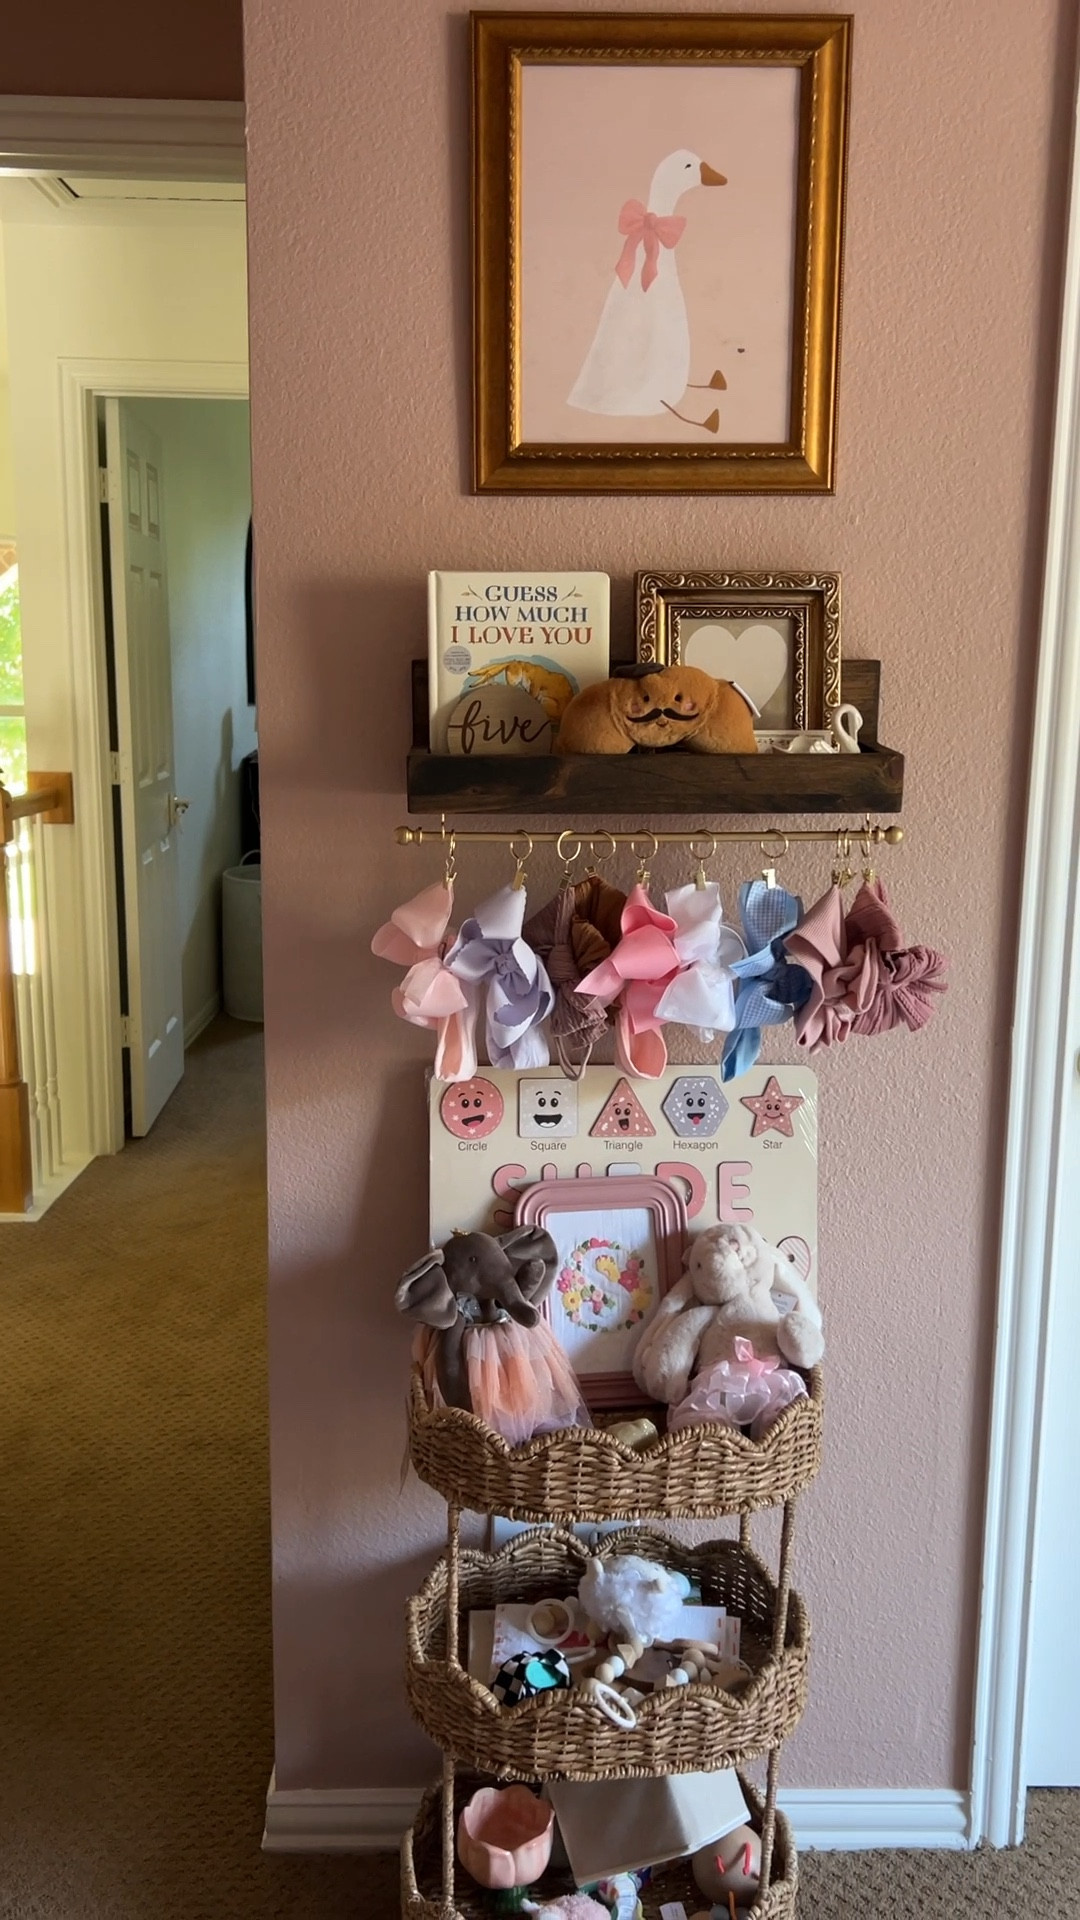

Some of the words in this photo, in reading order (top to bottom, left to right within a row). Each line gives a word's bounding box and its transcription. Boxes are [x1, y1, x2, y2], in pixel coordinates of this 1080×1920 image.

[485, 585, 558, 602] GUESS
[455, 605, 511, 622] HOW
[517, 606, 588, 623] MUCH
[450, 625, 460, 644] I
[468, 625, 534, 645] LOVE
[540, 626, 592, 645] YOU
[448, 700, 551, 755] five
[457, 1141, 488, 1151] Circle
[530, 1140, 567, 1152] Square
[603, 1140, 643, 1152] Triangle
[672, 1140, 719, 1152] Hexagon
[762, 1139, 783, 1149] Star
